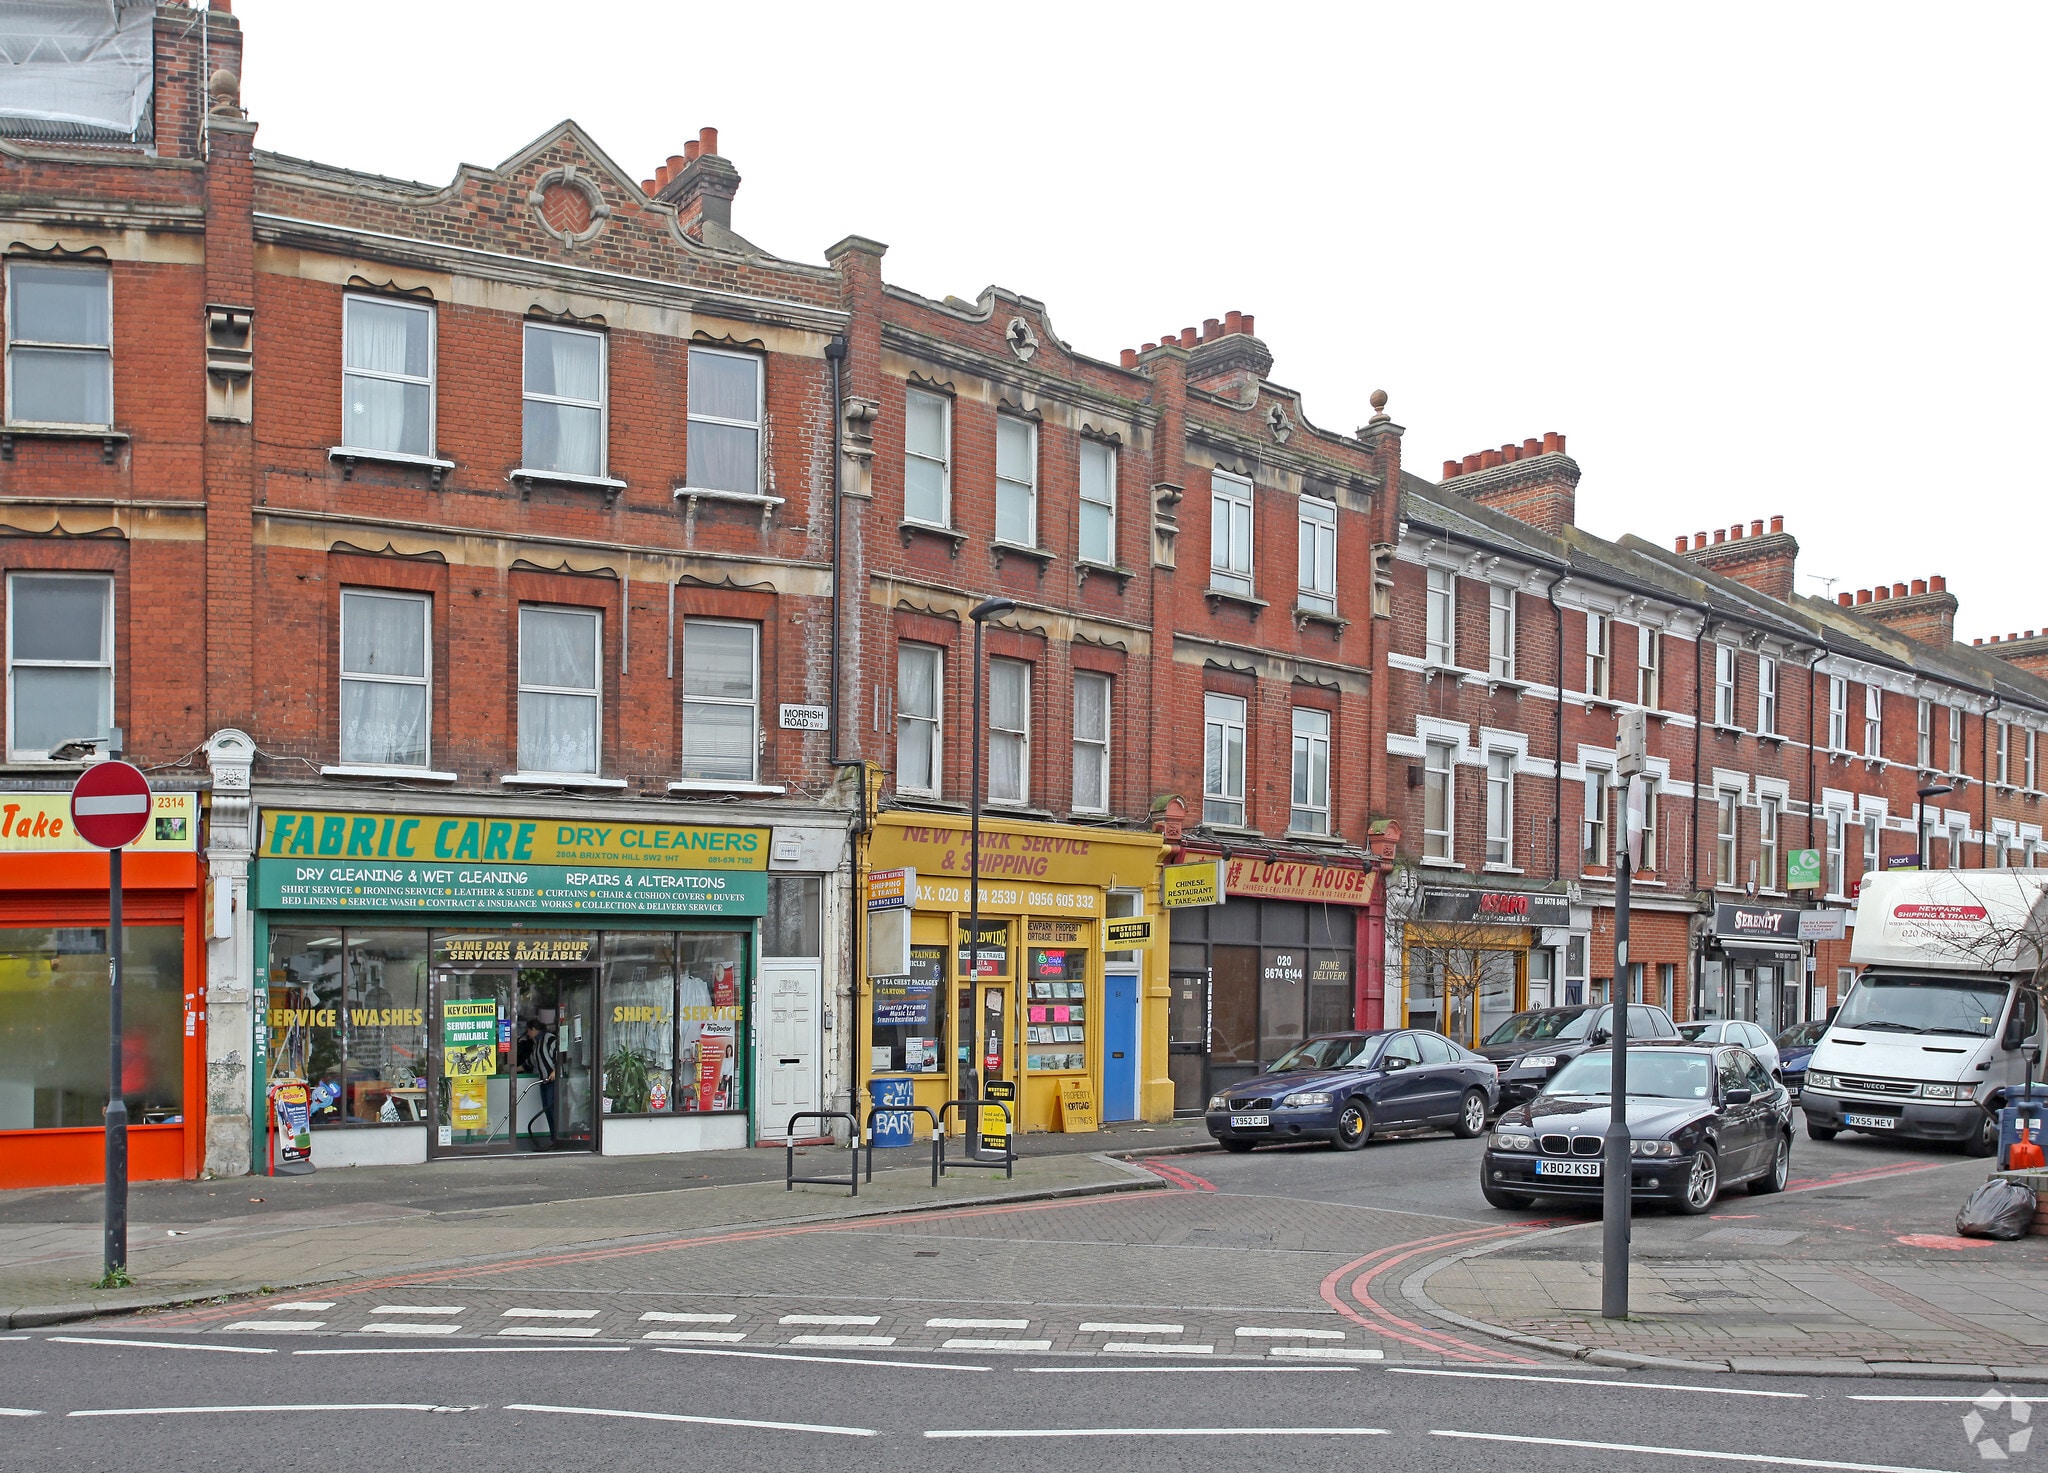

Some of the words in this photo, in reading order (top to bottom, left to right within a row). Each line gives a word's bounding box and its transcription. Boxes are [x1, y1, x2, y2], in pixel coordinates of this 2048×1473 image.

[784, 709, 824, 721] MORRISH
[784, 717, 809, 729] ROAD
[158, 798, 184, 809] 2314
[2, 804, 63, 838] Take
[270, 815, 421, 858] FABRIC
[434, 820, 537, 861] CARE
[557, 826, 612, 847] DRY
[620, 829, 758, 852] CLEANERS
[903, 827, 953, 845] NEW
[1020, 834, 1091, 855] SERVICE
[556, 851, 577, 859] 280A
[579, 852, 619, 861] BRIXTON
[643, 855, 662, 863] SW2
[941, 849, 955, 870] &
[960, 851, 1048, 876] SHIPPING
[296, 867, 325, 881] DRY
[329, 869, 404, 882] CLEANING
[409, 871, 418, 882] &
[422, 871, 454, 884] WET
[458, 872, 528, 886] CLEANING
[1226, 861, 1243, 888] 楼
[1250, 861, 1307, 887] LUCKY
[1312, 867, 1367, 892] HOUSE
[566, 873, 620, 887] REPAIRS
[625, 876, 634, 886] &
[637, 876, 726, 890] ALTERATIONS
[871, 880, 901, 890] SHIPPING
[1175, 879, 1205, 888] CHINESE
[281, 885, 311, 894] SHIRT
[312, 886, 353, 895] SERVICE
[363, 886, 404, 896] IRONING
[405, 887, 444, 897] SERVICE
[454, 888, 496, 898] LEATHER
[497, 889, 505, 897] &
[507, 889, 535, 898] SUEDE
[545, 889, 588, 899] CURTAINS
[878, 888, 900, 896] TRAVEL
[1168, 887, 1213, 897] RESTAURANT
[1242, 884, 1264, 892] CHINESE
[1269, 886, 1290, 895] ENGLISH
[1291, 888, 1304, 896] FOOD
[1308, 889, 1318, 897] EAT
[1333, 892, 1346, 900] TAKE
[282, 896, 299, 905] BED
[301, 897, 338, 906] LINENS
[348, 897, 389, 907] SERVICE
[390, 898, 416, 907] WASH
[597, 891, 624, 899] CHAIR
[626, 891, 633, 899] &
[634, 891, 670, 901] CUSHION
[672, 893, 705, 902] COVERS
[713, 894, 745, 903] DUVETS
[914, 887, 935, 902] AX:
[938, 888, 958, 903] 020
[964, 889, 988, 905] 874
[991, 890, 1016, 905] 2539
[1028, 892, 1053, 907] 0956
[1055, 894, 1074, 908] 605
[1075, 894, 1094, 909] 332
[1174, 895, 1214, 905] TAKE-AWAY
[426, 899, 476, 908] CONTRACT
[478, 900, 485, 908] &
[487, 900, 537, 909] INSURANCE
[541, 900, 573, 910] WORKS
[582, 901, 637, 910] COLLECTION
[638, 902, 645, 911] &
[646, 902, 688, 911] DELIVERY
[689, 904, 722, 912] SERVICE
[1918, 905, 1962, 913] NEWPARK
[1734, 911, 1782, 932] SERENITY
[1056, 923, 1083, 932] PROPERTY
[1109, 924, 1142, 933] WESTERN
[1028, 933, 1051, 941] ORTGAGE
[1056, 934, 1077, 942] LETTING
[1119, 930, 1142, 939] UNION
[1902, 930, 1919, 938] 020
[445, 940, 482, 951] SAME
[486, 941, 512, 951] DAY
[517, 941, 526, 951] &
[533, 941, 549, 951] 24
[553, 941, 589, 951] HOUR
[450, 950, 510, 961] SERVICES
[514, 950, 583, 961] AVAILABLE
[1277, 955, 1293, 967] 020
[1320, 961, 1340, 971] HOME
[1264, 968, 1283, 980] 8674
[1284, 969, 1303, 981] 6144
[1312, 971, 1347, 981] DELIVERY
[912, 979, 938, 987] PACKAGES
[448, 1005, 461, 1017] KEY
[462, 1004, 494, 1015] CUTTING
[902, 1003, 927, 1011] Pyramid
[266, 1009, 337, 1027] SERVICE
[351, 1009, 423, 1028] WASHES
[613, 1006, 662, 1023] SHIRT
[683, 1006, 743, 1022] SERVICE
[446, 1021, 476, 1031] SERVICE
[477, 1020, 494, 1030] NOW
[453, 1032, 489, 1042] AVAILABLE
[1863, 1083, 1886, 1091] IVECO
[1064, 1091, 1090, 1100] PROPERTY
[1067, 1116, 1093, 1126] LETTINGS
[1235, 1117, 1252, 1125] X952
[1850, 1116, 1873, 1126] RX55
[1542, 1161, 1571, 1174] KB02
[1574, 1163, 1597, 1175] KSB
